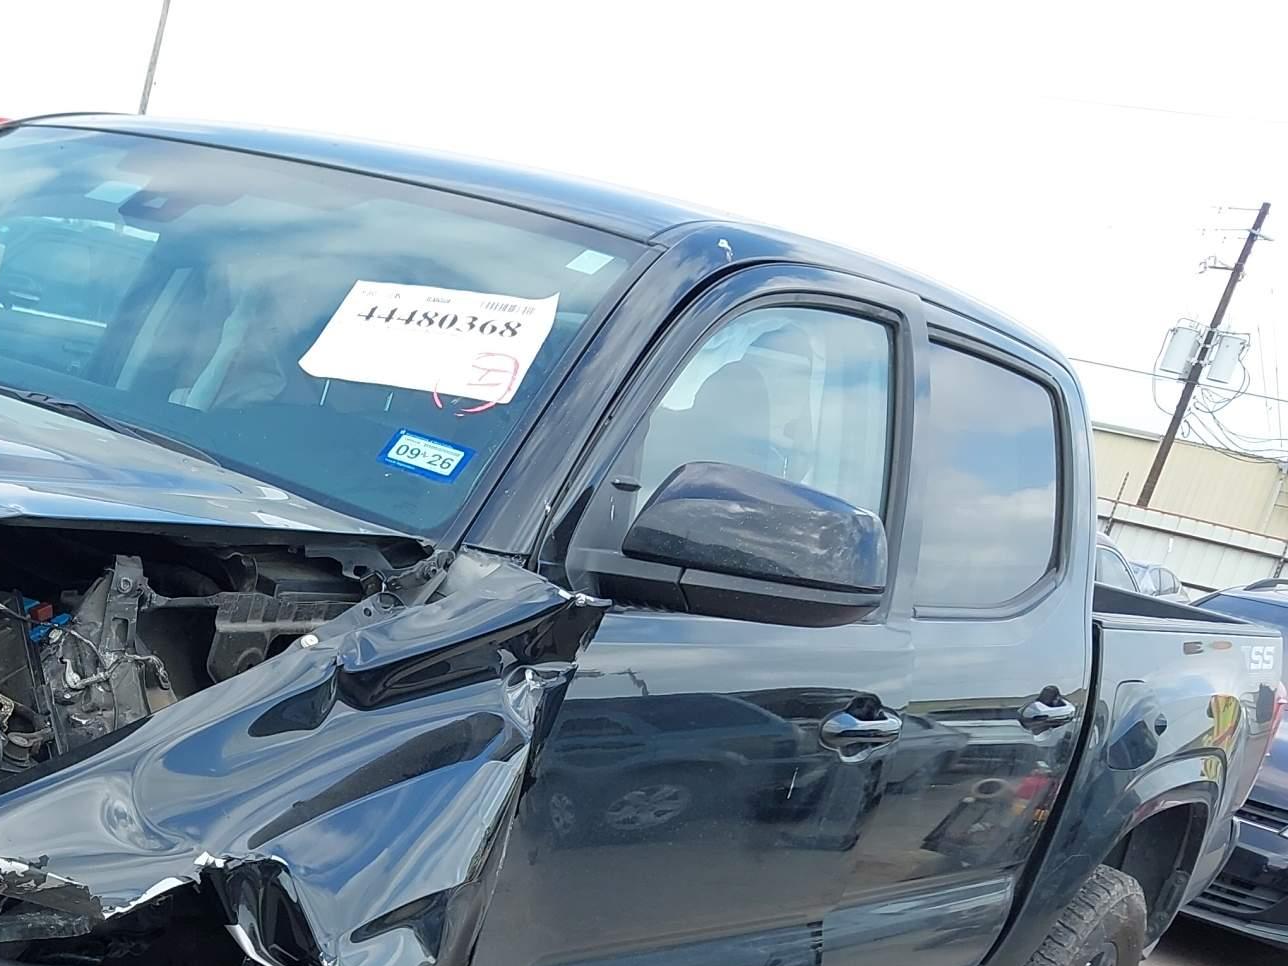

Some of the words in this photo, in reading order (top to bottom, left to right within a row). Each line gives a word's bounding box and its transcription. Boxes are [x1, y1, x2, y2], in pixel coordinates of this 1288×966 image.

[358, 306, 522, 337] 44480368
[396, 444, 421, 460] 09
[427, 453, 454, 470] 26
